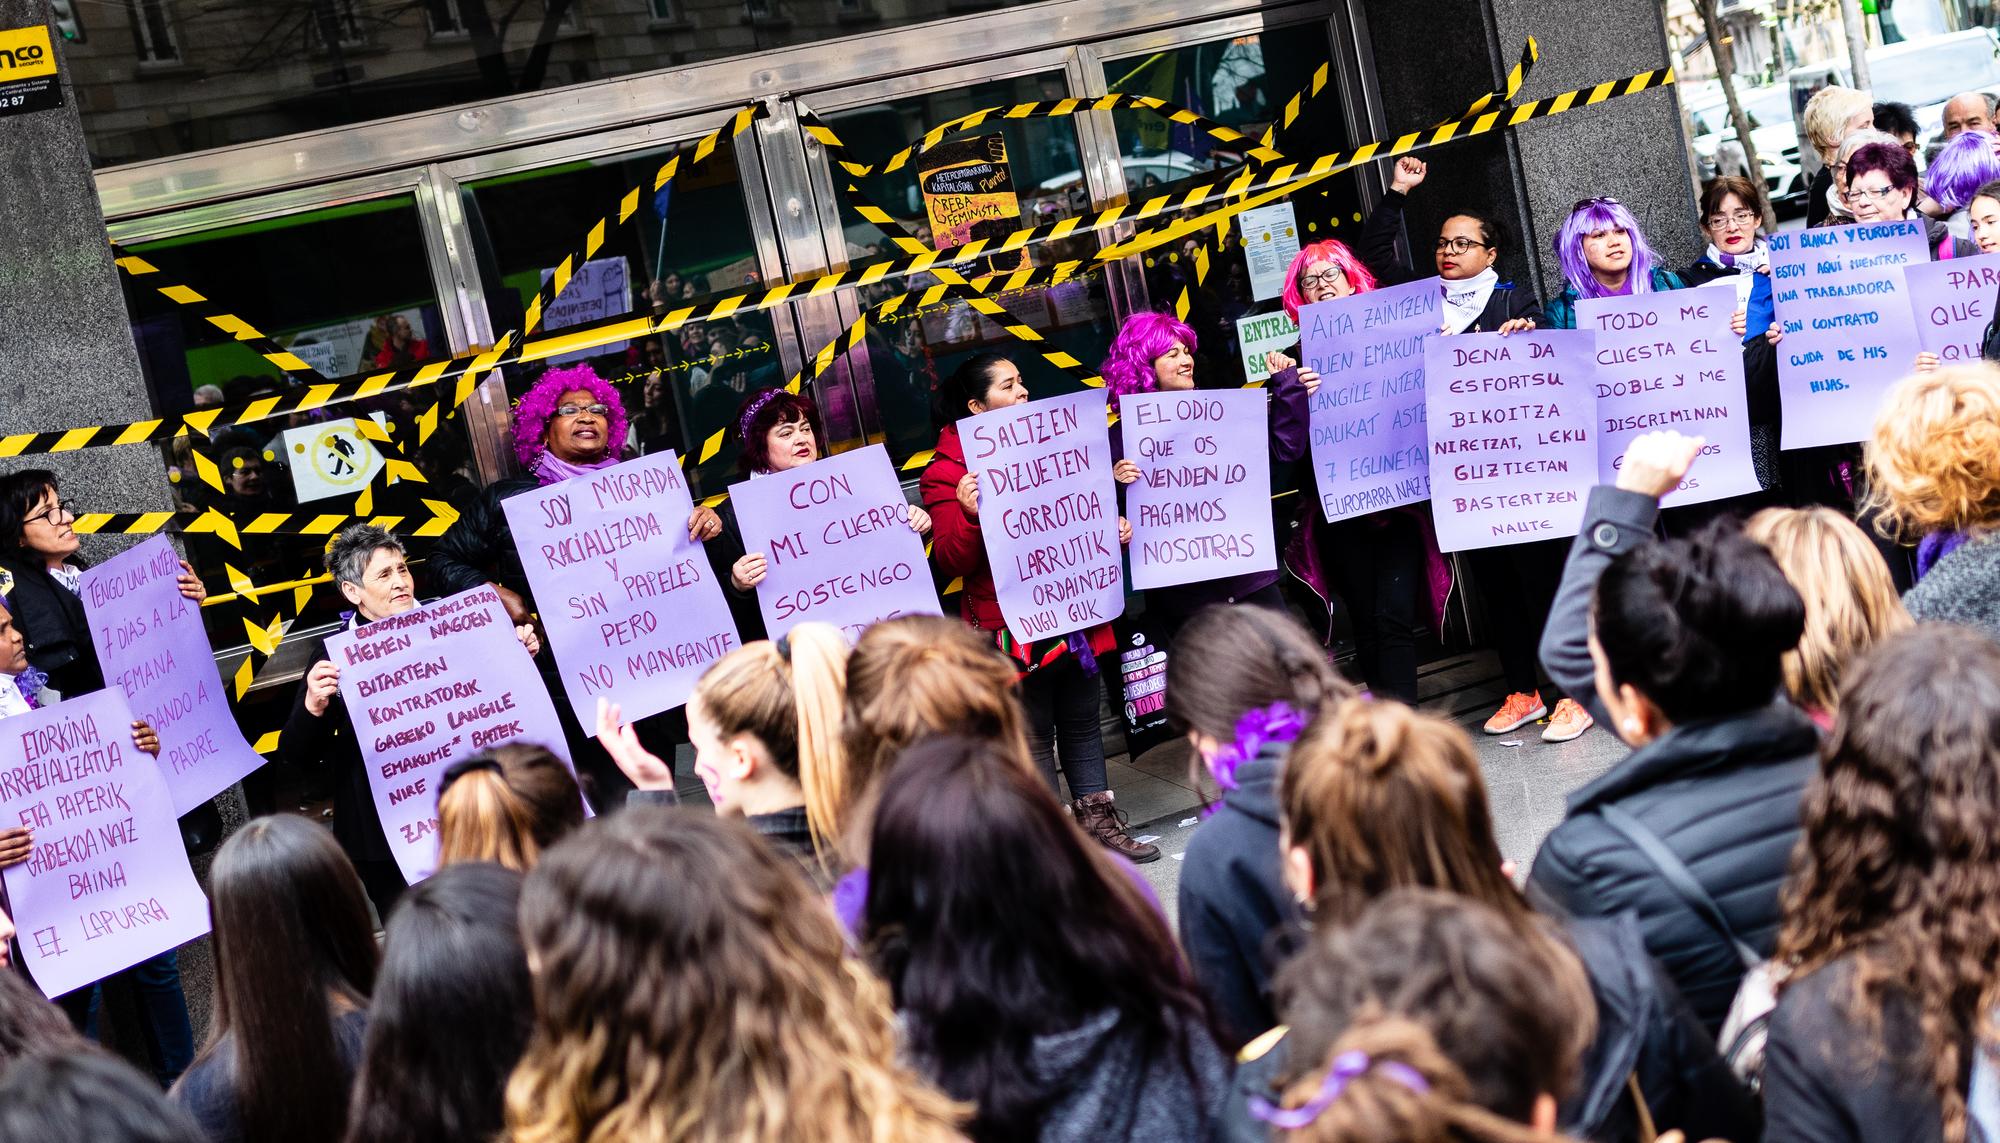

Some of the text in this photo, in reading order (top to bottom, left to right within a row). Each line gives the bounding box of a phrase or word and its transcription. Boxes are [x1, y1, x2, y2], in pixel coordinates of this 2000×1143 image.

[19, 60, 44, 68] security
[11, 95, 25, 106] 87
[932, 195, 973, 224] GREBA
[1769, 223, 1919, 252] SOY BLANCA Y EUROPEA
[1775, 264, 1807, 280] ESTOY
[1777, 279, 1896, 304] UNA TRABAJADORA
[1596, 305, 1709, 331] TODO ME
[1783, 311, 1880, 335] SIN CONTRATO
[1931, 299, 1983, 326] QUE
[1310, 351, 1354, 377] DUEN
[1452, 343, 1556, 367] DENA DA
[1596, 339, 1718, 366] CUESTA EL
[1838, 349, 1856, 362] DE
[1863, 346, 1888, 360] MIS
[1450, 372, 1564, 393] ESFORTSU
[1596, 377, 1665, 399] DOBLE
[1699, 369, 1727, 383] ME
[1136, 403, 1171, 426] EL
[1313, 402, 1427, 447] DAUKAT ASTE
[1450, 403, 1561, 428] BIKOITZA
[1604, 405, 1728, 433] DISCRIMINAN
[973, 403, 1078, 459] SALTZEN
[1434, 429, 1587, 456] NIRETZAT, LEKU
[1138, 435, 1218, 463] QUE OS
[1140, 464, 1247, 489] VENDEN LO
[1325, 461, 1337, 484] 7
[1454, 460, 1569, 482] GUZTIETAN
[789, 473, 853, 510] CON
[1323, 485, 1396, 518] EUROPARRA
[1452, 490, 1578, 514] BASTERTZEN
[540, 494, 573, 529] SOY
[1002, 491, 1103, 540] GORROTOA
[1140, 497, 1227, 528] PAGAMOS
[769, 502, 910, 565] MI CUERPO
[1491, 519, 1554, 537] NAUTE
[1143, 533, 1255, 566] NOSOTRAS
[604, 558, 619, 582] Y
[622, 558, 700, 602] PAPELES
[87, 576, 125, 610] TENGO
[127, 566, 148, 592] UNA
[775, 562, 912, 620] SOSTENGO
[102, 626, 113, 660] 7
[153, 608, 164, 629] A
[170, 597, 189, 622] LA
[355, 611, 431, 640] EUROPARRA
[600, 610, 657, 648] PERO
[1019, 598, 1103, 638] DUGU GUK
[344, 608, 493, 666] HEMEN NAGOEN
[116, 648, 177, 700] SEMANA
[356, 656, 448, 698] BITARTEAN
[579, 663, 614, 696] NO
[198, 679, 210, 705] A
[367, 679, 482, 726] KONTRATORIK
[374, 692, 517, 753] GABEKO LANGILE
[471, 720, 524, 749] BATEK
[169, 728, 220, 775] PADRE
[388, 778, 427, 806] NIRE
[18, 800, 52, 832] ETA
[25, 829, 99, 878] GABEKOA
[80, 897, 170, 941] LAPURRA
